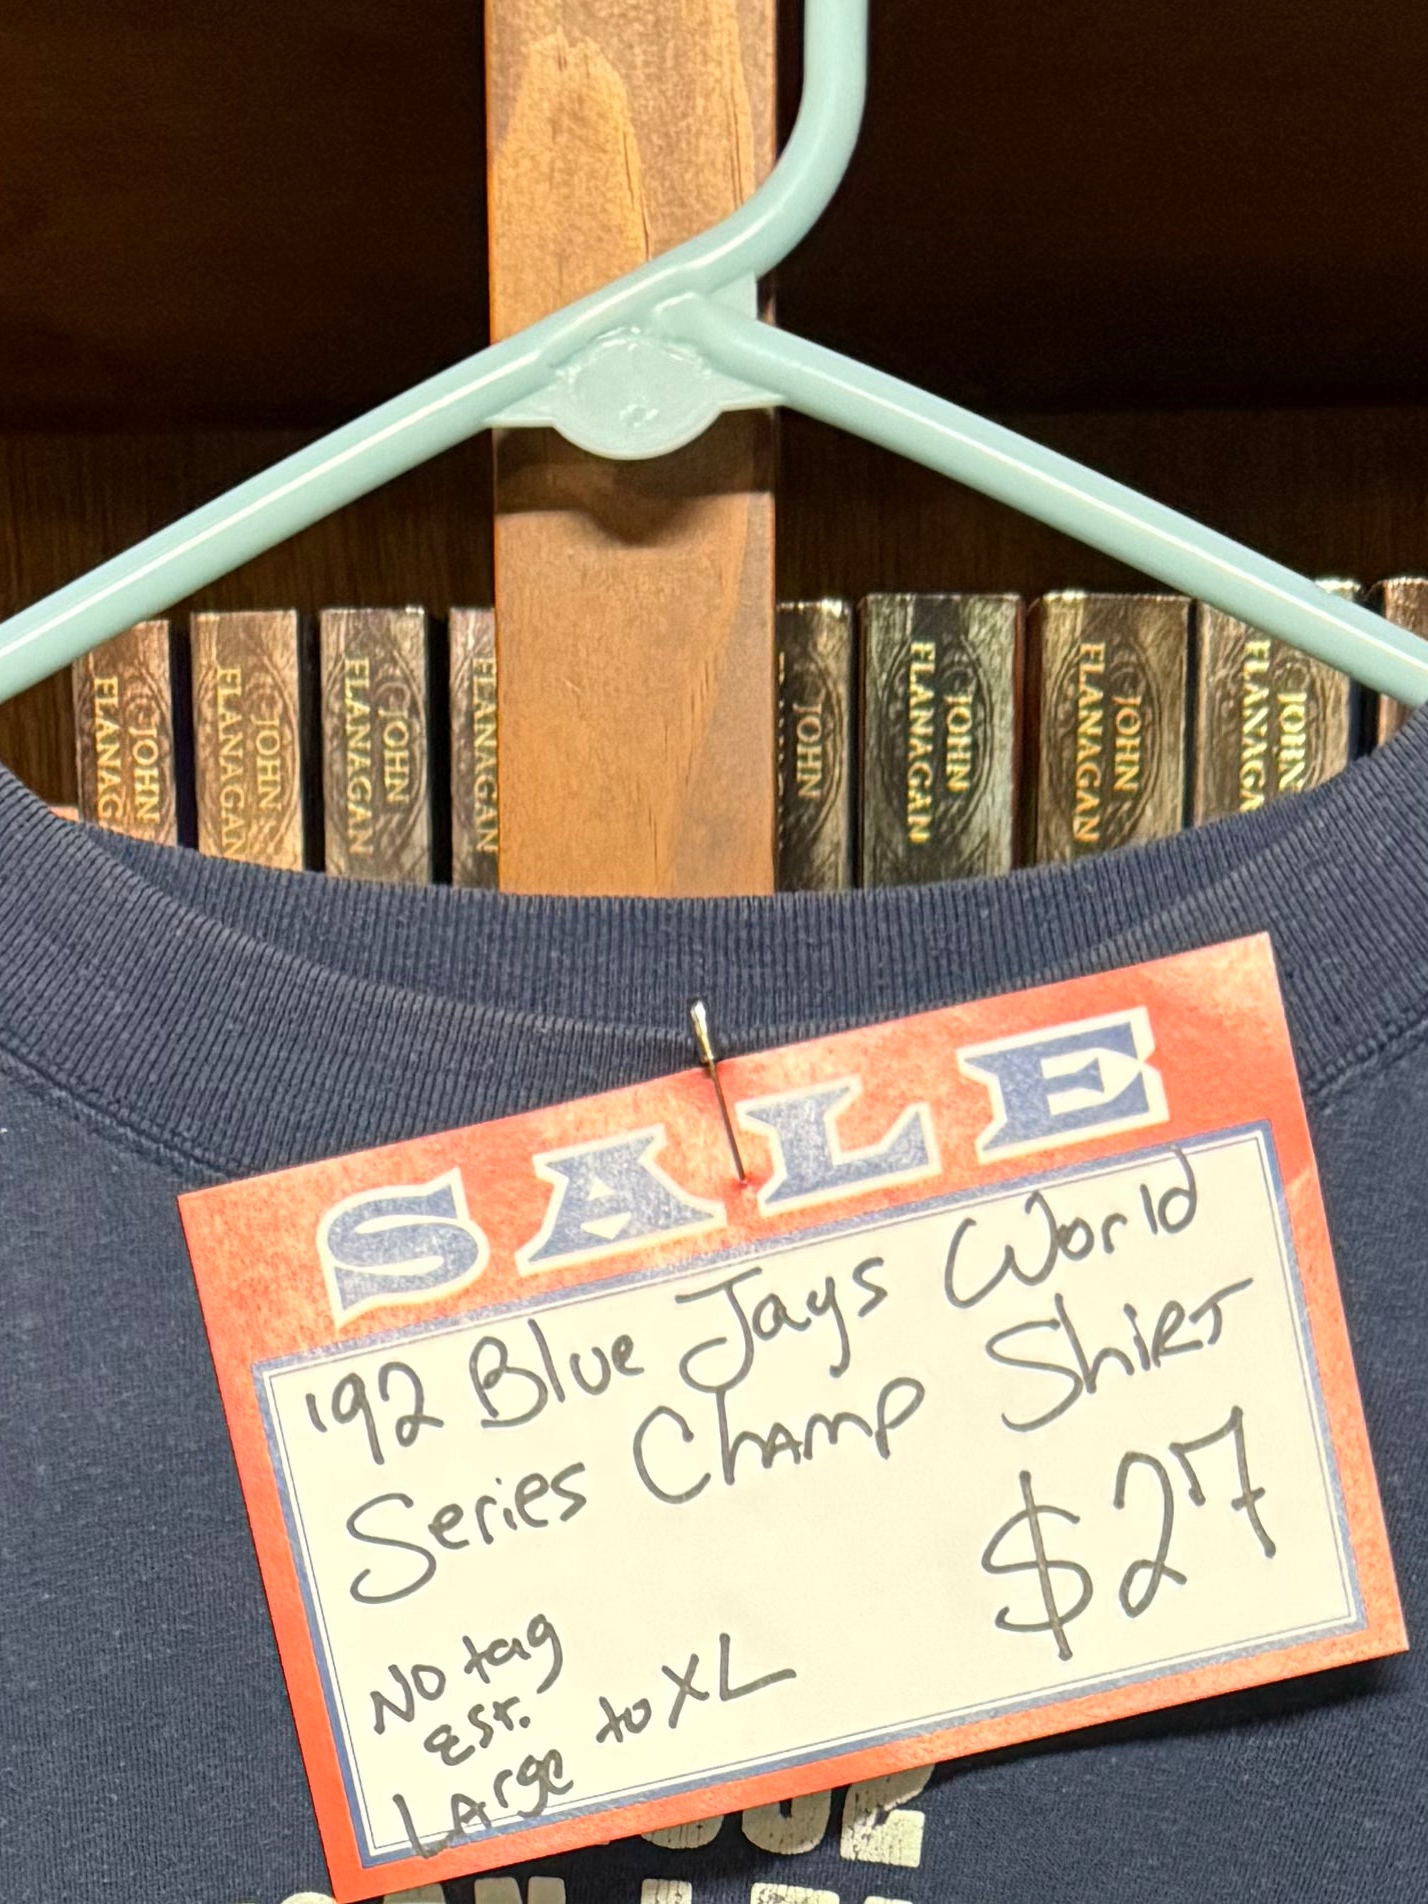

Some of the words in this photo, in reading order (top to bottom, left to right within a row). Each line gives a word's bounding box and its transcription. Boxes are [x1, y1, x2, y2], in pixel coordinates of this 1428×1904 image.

[94, 676, 122, 823] FLANAG
[129, 721, 160, 823] JOHN
[217, 666, 243, 857] FLANAGAN
[251, 713, 281, 822] JOHN
[345, 657, 373, 854] FLANAGAN
[378, 709, 409, 803] JOHN
[473, 657, 497, 853] FLANAGAN
[795, 703, 823, 800] JOHN
[908, 641, 936, 843] FLANAGAN
[946, 695, 973, 793] JOHN
[1073, 641, 1106, 843] FLANAGAN
[1114, 695, 1142, 794] JOHN
[1239, 638, 1270, 812] FLANAGA
[1277, 692, 1307, 794] JOHN
[316, 1006, 1170, 1328] SALE
[468, 1318, 645, 1428] Blue
[675, 1256, 888, 1392] Jays
[944, 1146, 1199, 1310] World
[347, 1461, 587, 1605] Series
[982, 1405, 1276, 1660] $27
[462, 1613, 564, 1694] tag
[595, 1695, 652, 1743] to
[661, 1633, 796, 1728] XL
